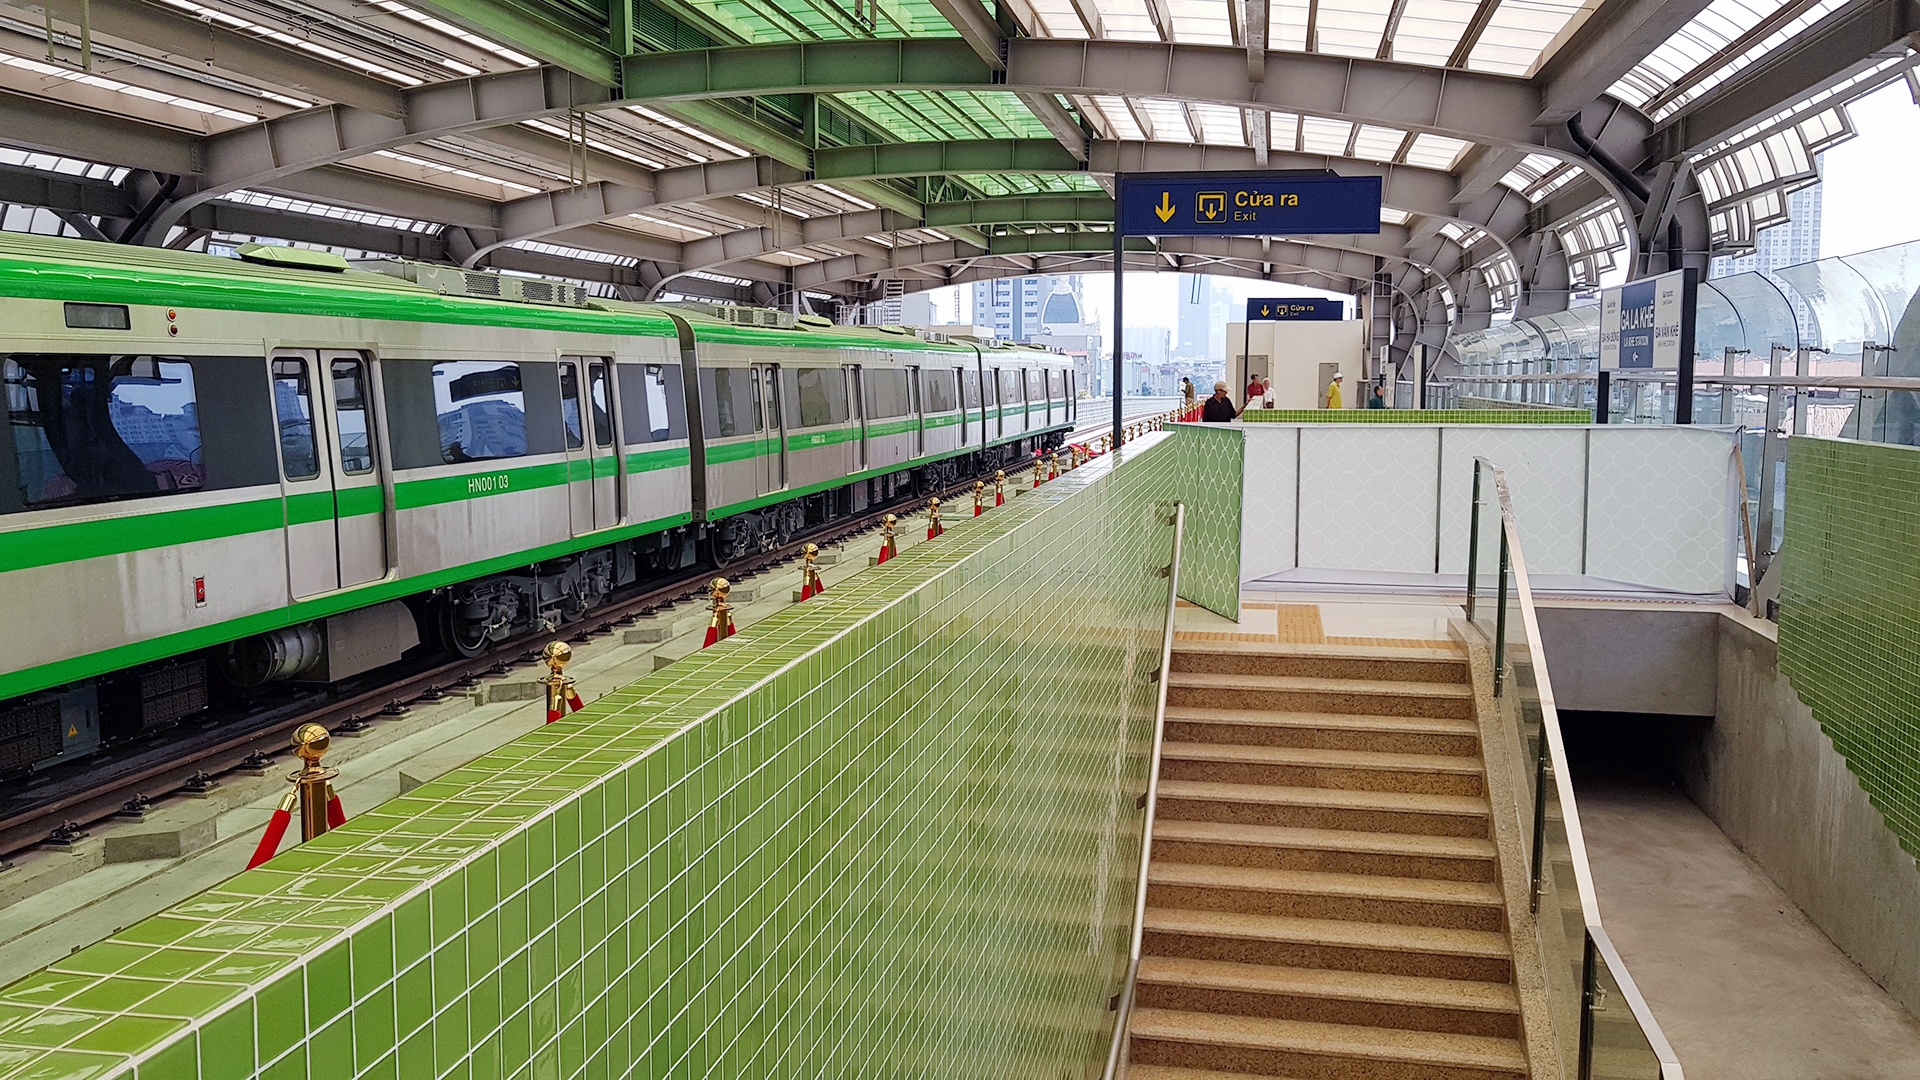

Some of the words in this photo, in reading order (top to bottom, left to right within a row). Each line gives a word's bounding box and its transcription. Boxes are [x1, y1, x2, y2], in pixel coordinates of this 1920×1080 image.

[1235, 190, 1274, 207] Cửa
[1280, 194, 1299, 206] ra
[1234, 211, 1257, 221] Exit
[1621, 309, 1630, 331] GA
[1630, 307, 1639, 330] LA
[468, 475, 497, 493] HN001
[498, 474, 509, 489] 03
